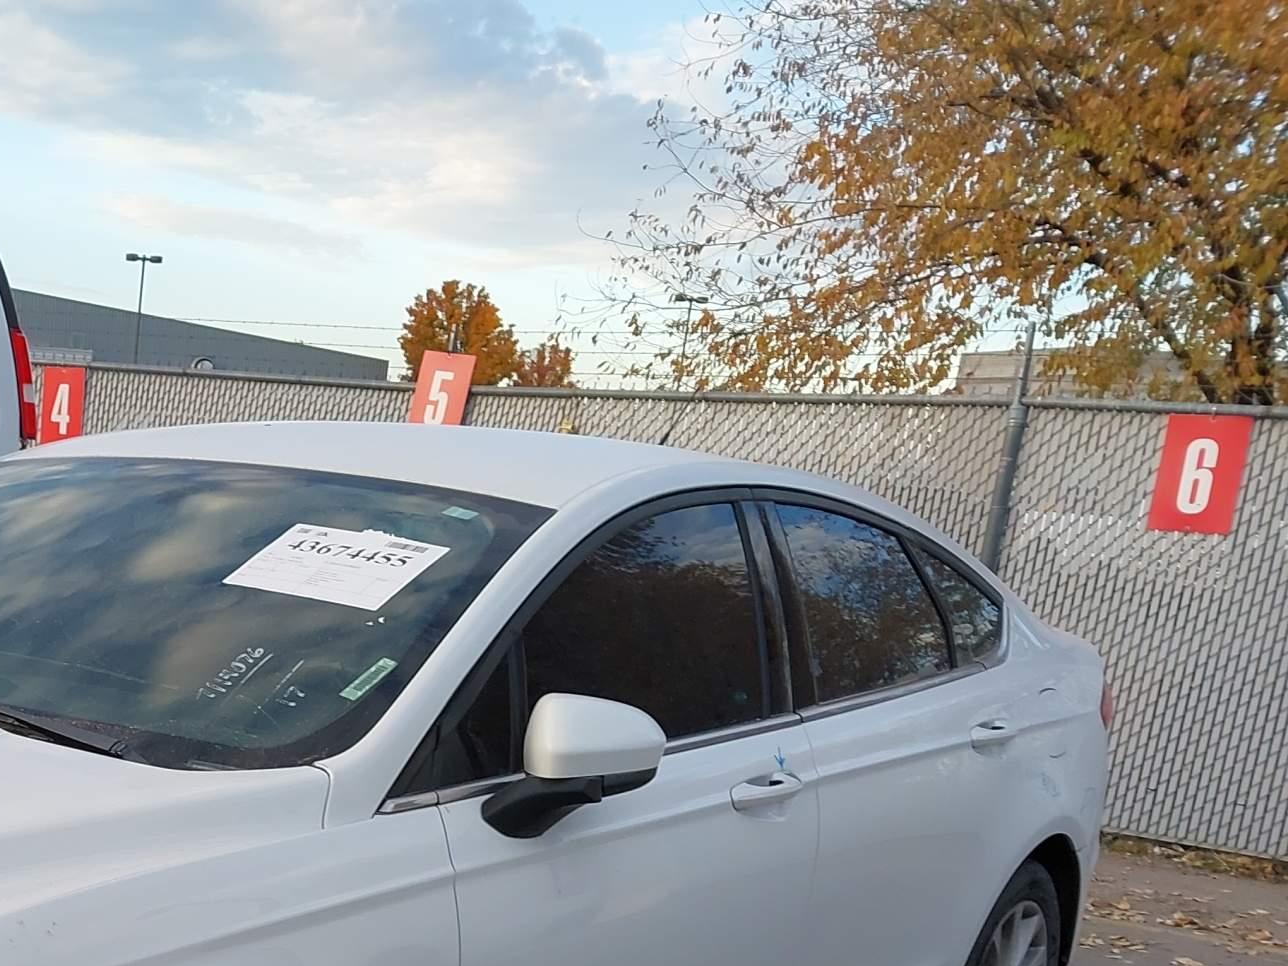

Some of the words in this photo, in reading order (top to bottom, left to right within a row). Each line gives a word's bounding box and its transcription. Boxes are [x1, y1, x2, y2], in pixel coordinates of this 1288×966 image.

[50, 383, 70, 435] 4
[423, 370, 455, 425] 5
[1176, 438, 1220, 514] 6
[287, 538, 414, 567] 43674455
